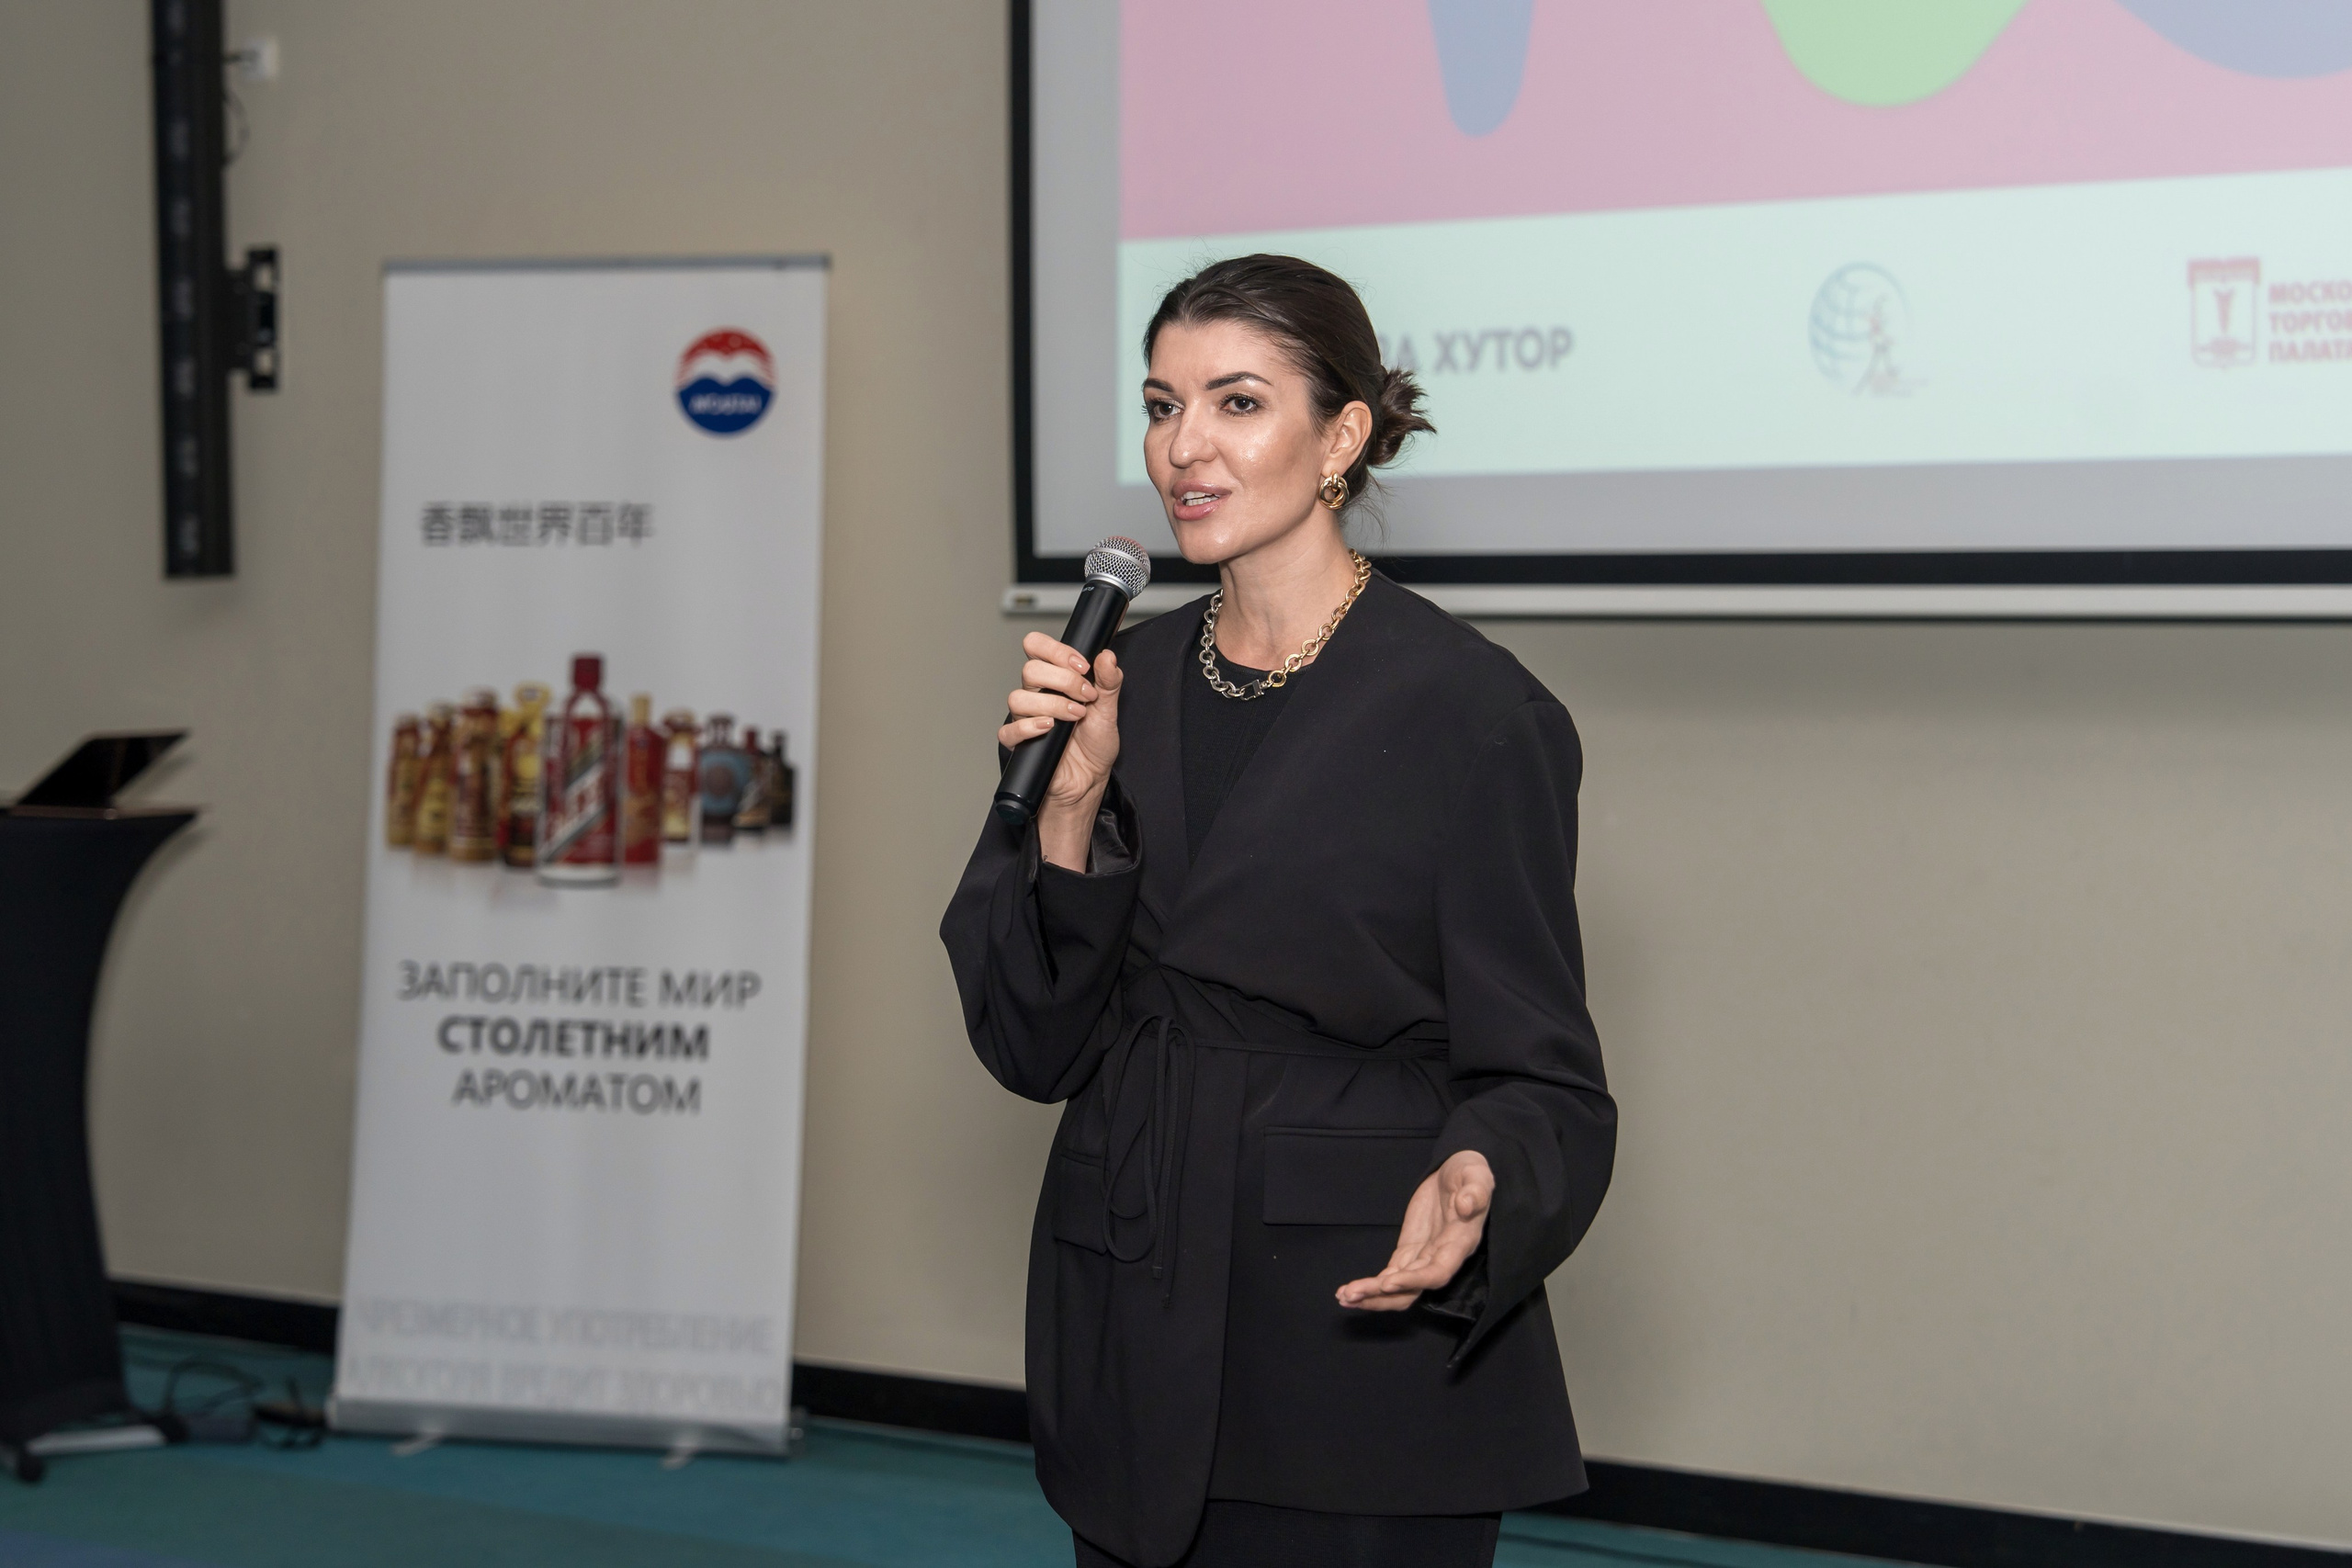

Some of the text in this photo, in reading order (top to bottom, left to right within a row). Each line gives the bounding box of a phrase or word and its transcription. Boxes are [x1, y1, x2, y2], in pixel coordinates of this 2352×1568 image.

[1434, 327, 1572, 371] ХУТОР
[398, 959, 763, 1010] ЗАПОЛНИТЕ МИР
[437, 1015, 710, 1061] СТОЛЕТНИМ
[451, 1068, 702, 1115] АРОМАТОМ
